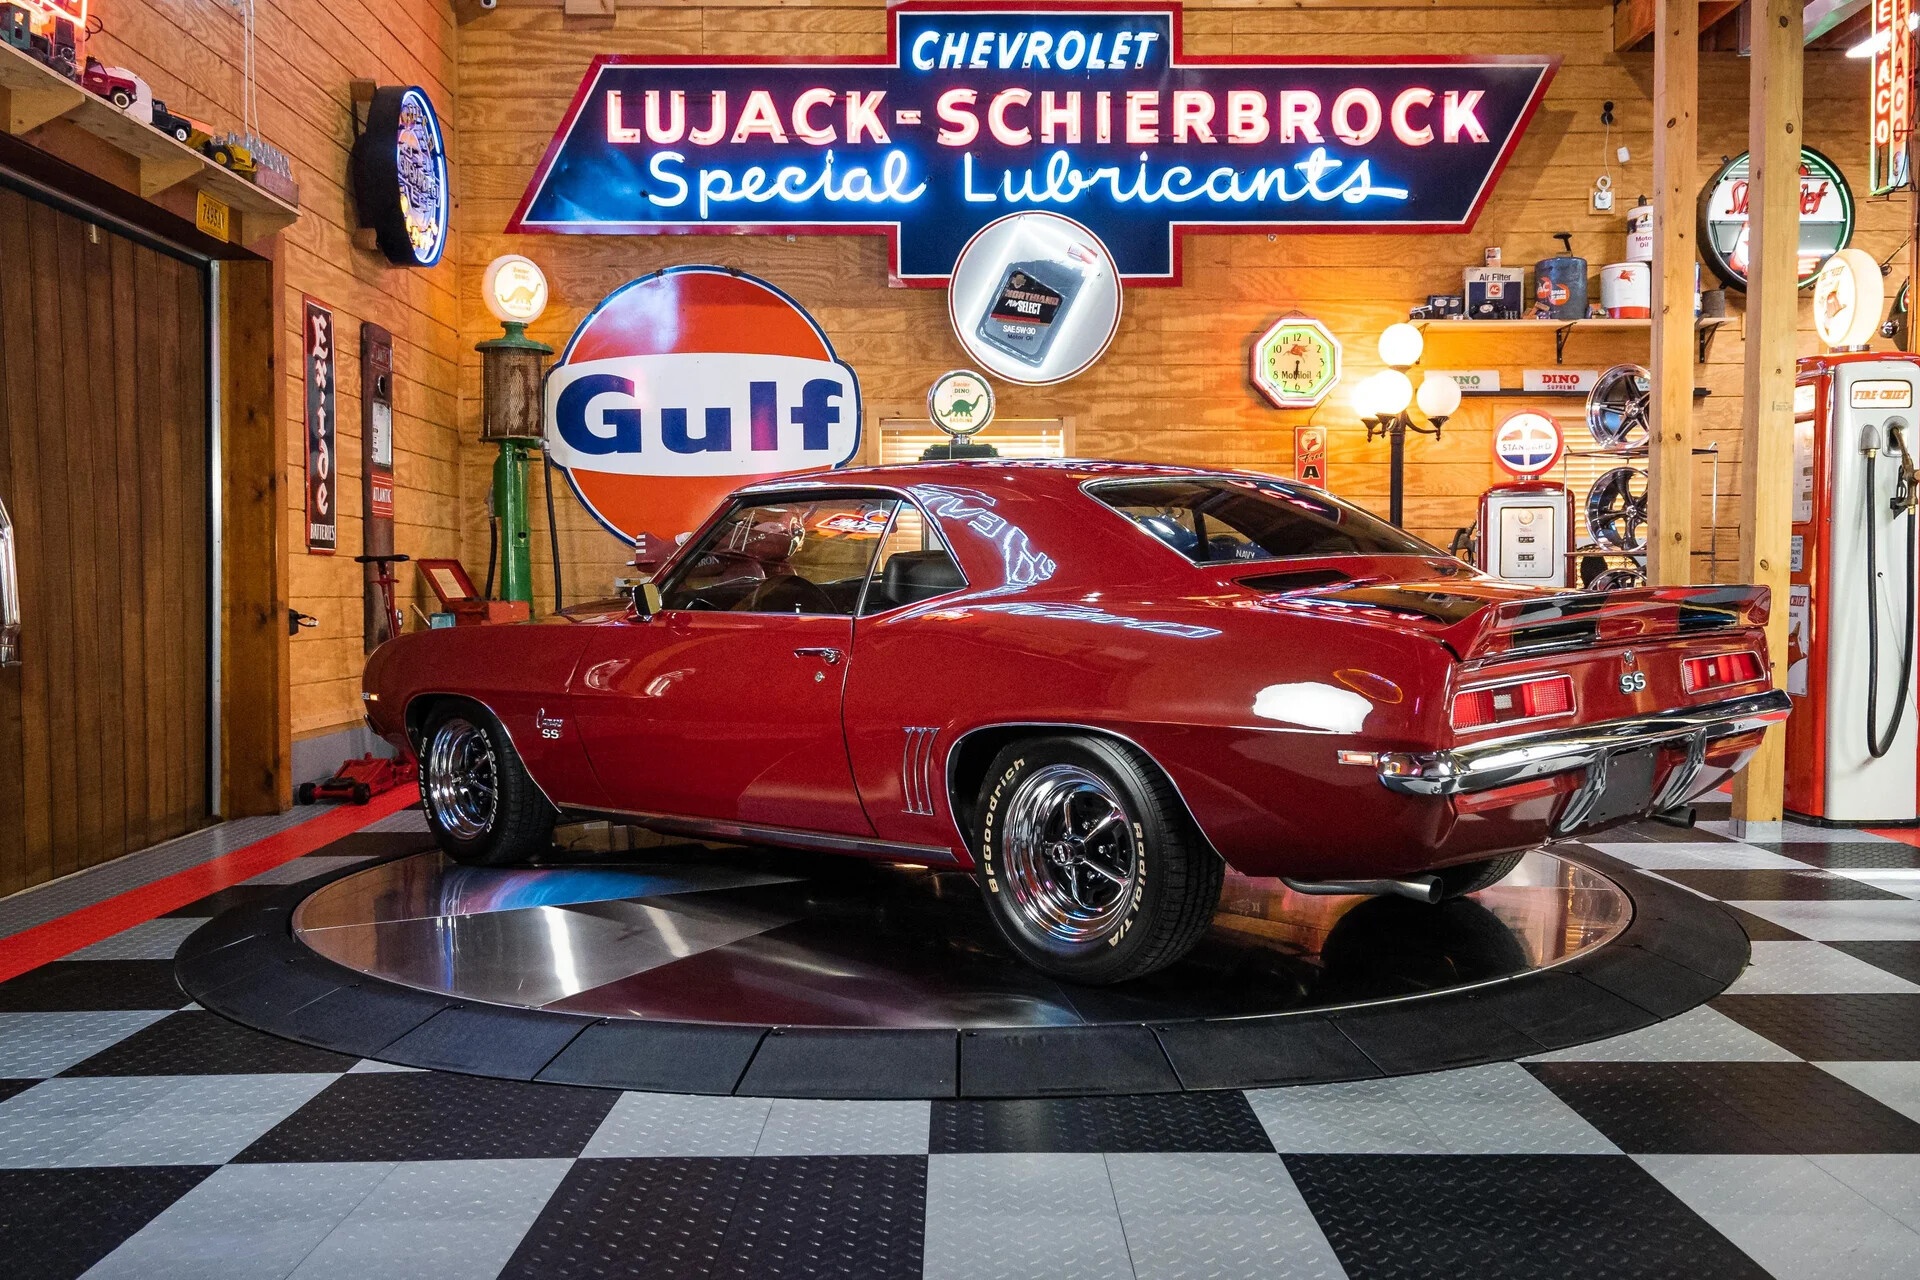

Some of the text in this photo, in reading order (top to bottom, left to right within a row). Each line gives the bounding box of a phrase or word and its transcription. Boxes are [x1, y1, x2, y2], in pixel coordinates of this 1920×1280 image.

[911, 29, 1160, 71] CHEVROLET
[648, 147, 1409, 220] Special Lubricants
[1478, 273, 1512, 281] Air Filter
[1282, 336, 1289, 345] 11
[1293, 333, 1302, 342] 12
[1273, 344, 1322, 354] 10 2
[1269, 357, 1325, 367] 9 3
[1272, 370, 1279, 380] 8
[1315, 371, 1322, 379] 4
[1453, 375, 1481, 385] INO
[1541, 374, 1580, 384] DINO
[1294, 383, 1301, 391] 6
[1308, 380, 1314, 388] 5
[311, 313, 330, 516] Exide
[556, 373, 843, 455] Gulf
[1298, 451, 1325, 464] Free
[1301, 465, 1321, 479] A
[373, 486, 393, 503] ATLANTIC
[310, 522, 336, 542] BATTERIES
[1235, 549, 1255, 559] NAVY
[1619, 670, 1647, 695] SS
[541, 728, 560, 739] SS
[982, 757, 1026, 894] BFGoodrich
[1132, 822, 1148, 913] Radial
